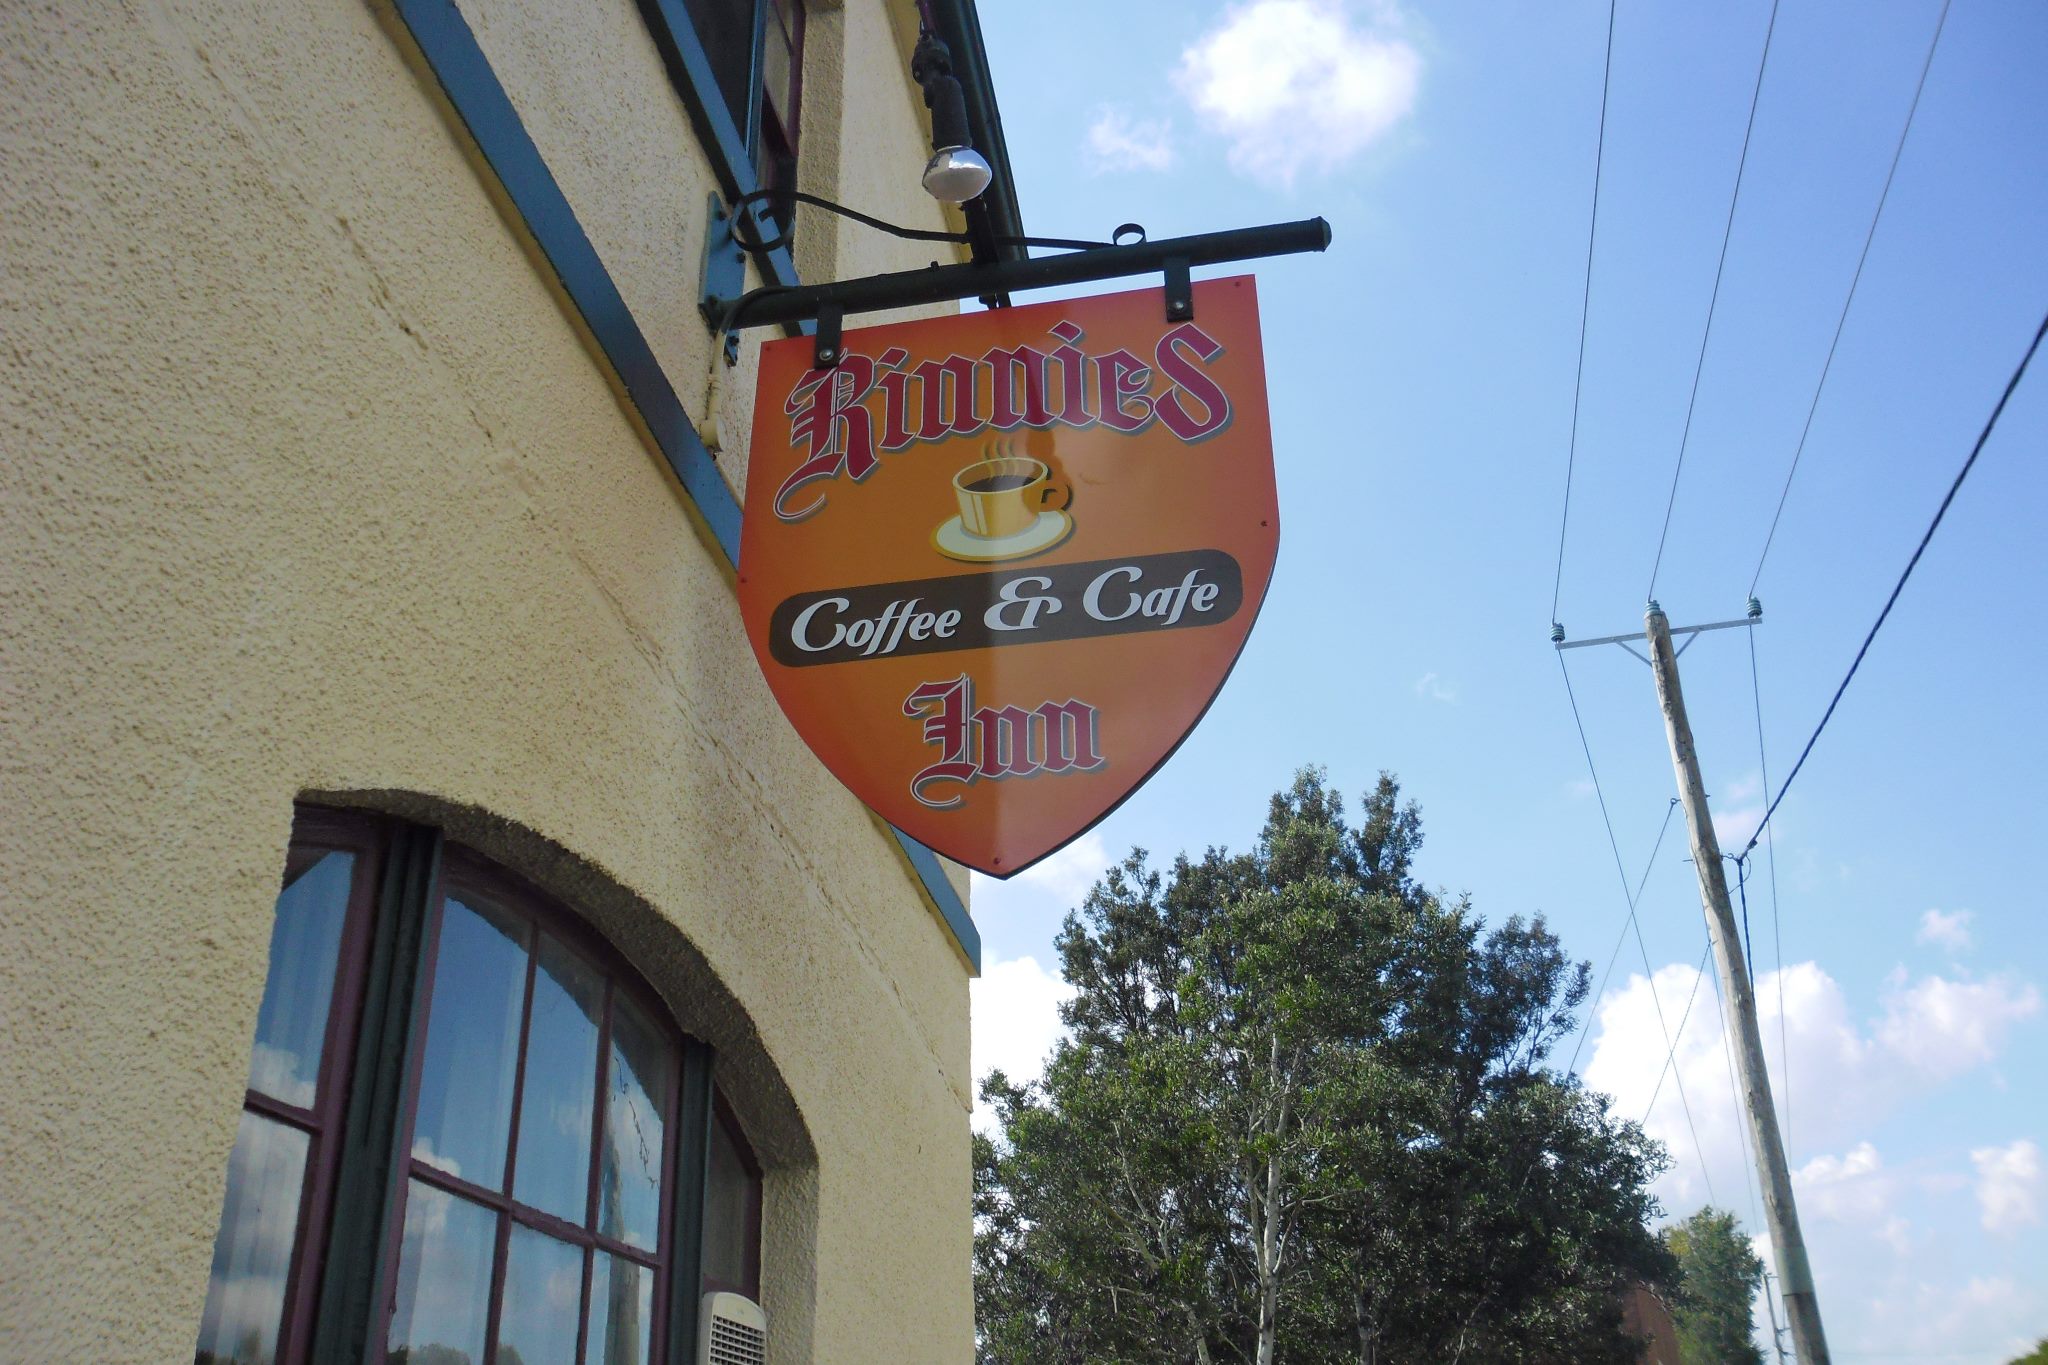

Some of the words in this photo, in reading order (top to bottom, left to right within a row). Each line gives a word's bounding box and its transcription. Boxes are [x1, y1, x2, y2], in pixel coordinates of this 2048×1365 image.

[790, 596, 962, 656] Coffee
[983, 576, 1062, 631] &
[1082, 566, 1219, 626] Cafe
[902, 673, 1106, 808] Inn
